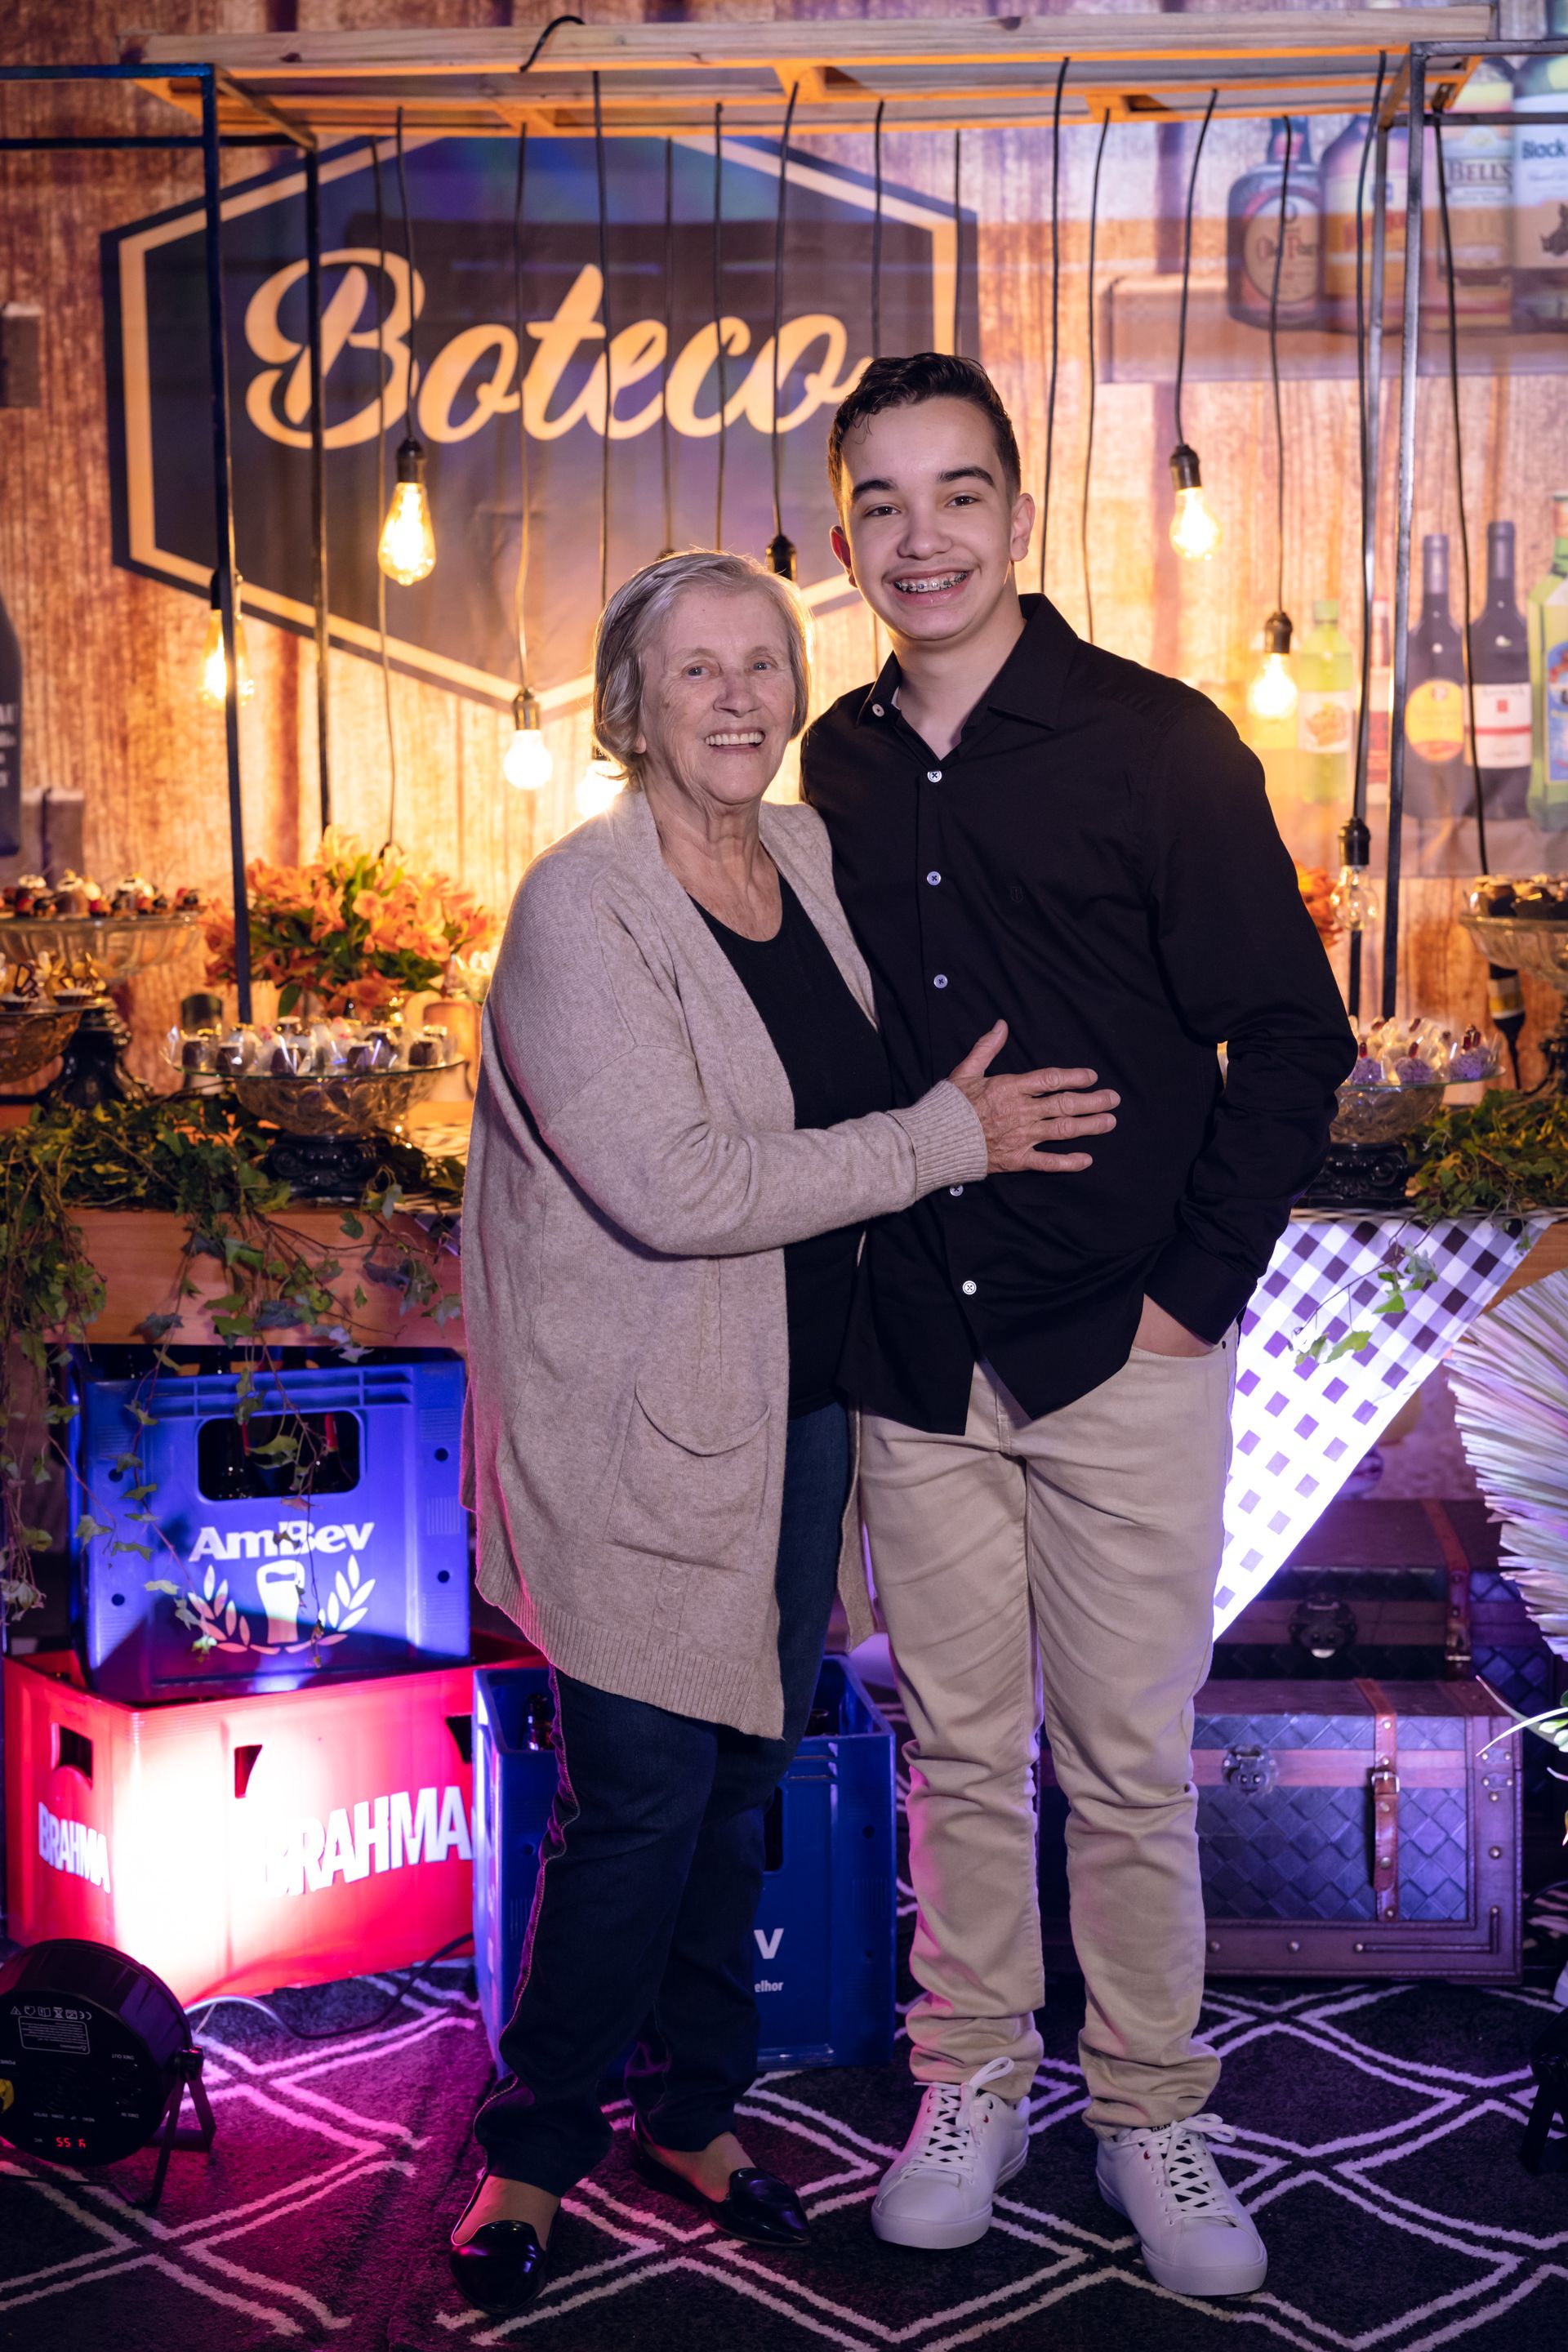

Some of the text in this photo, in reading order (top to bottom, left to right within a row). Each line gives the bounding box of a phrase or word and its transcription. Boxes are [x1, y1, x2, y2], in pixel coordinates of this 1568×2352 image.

[244, 247, 872, 450] Boteco
[188, 1520, 376, 1562] AmBev
[38, 1801, 111, 1895] BRAHMA
[754, 1980, 784, 1993] elhor
